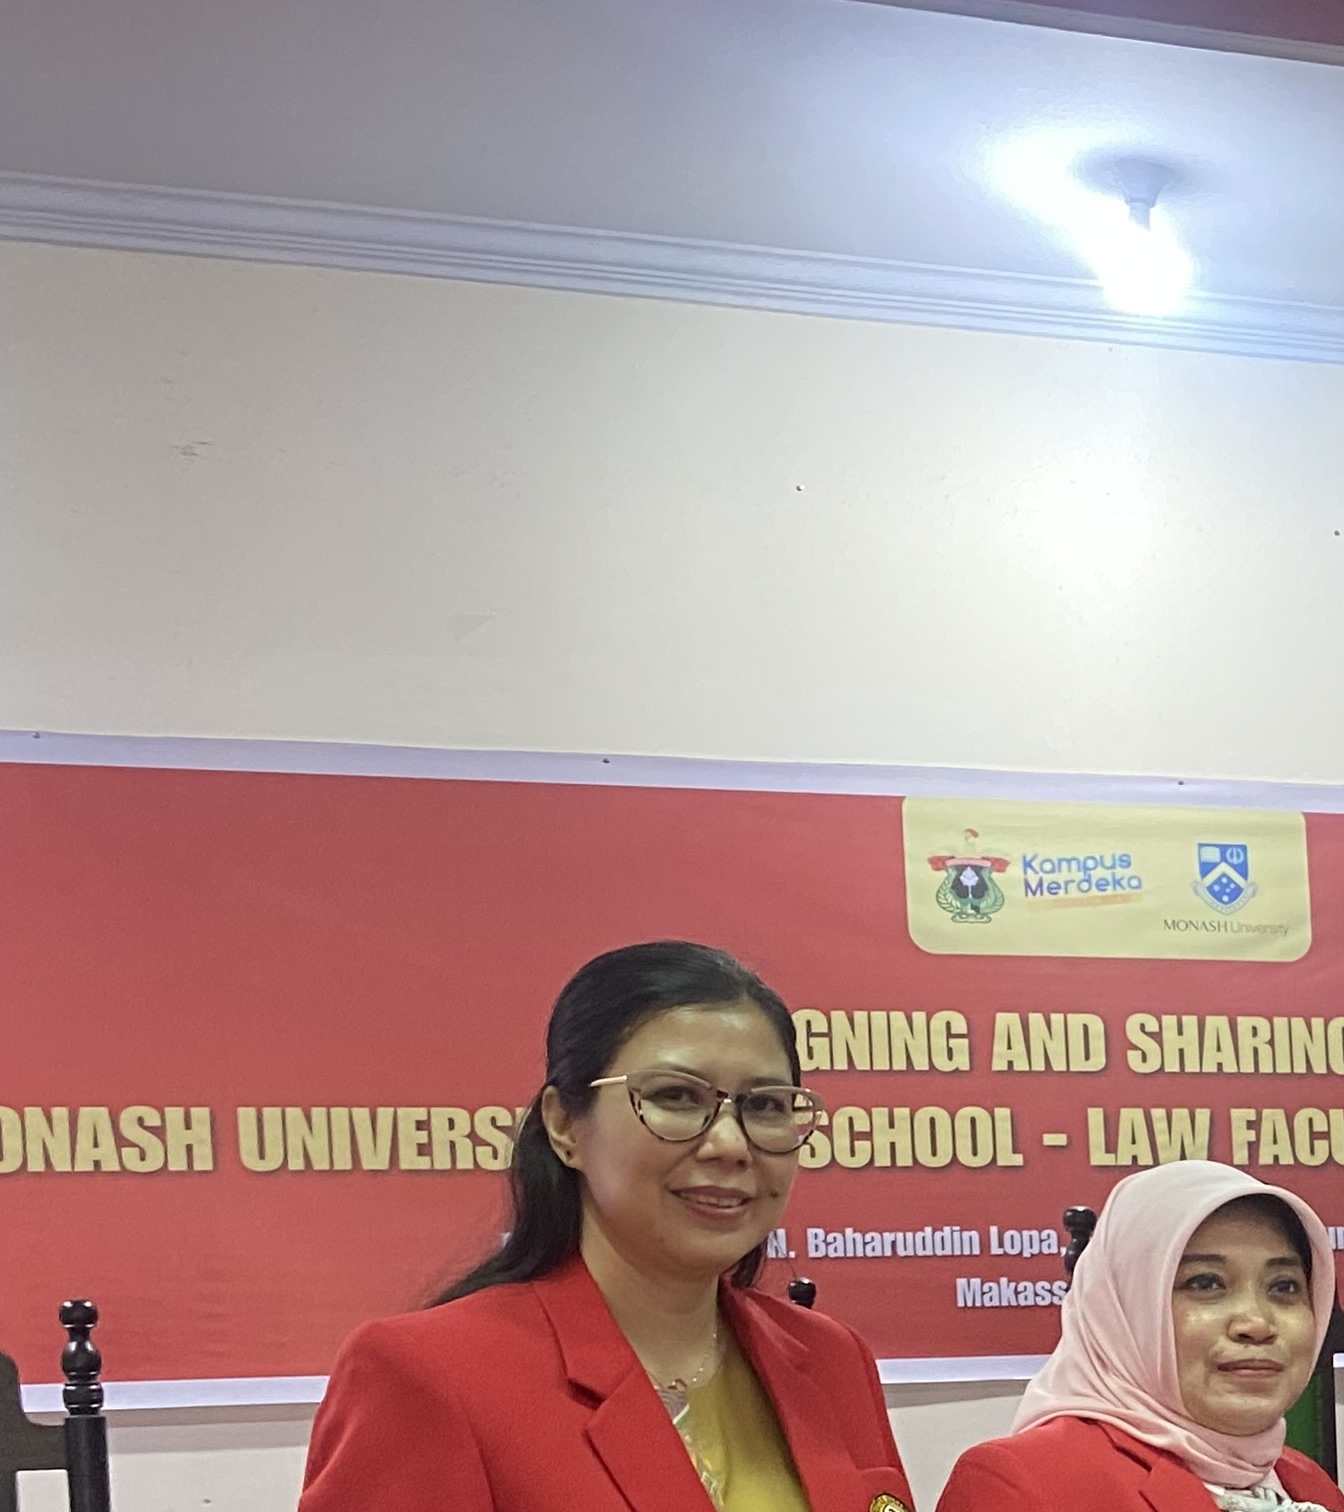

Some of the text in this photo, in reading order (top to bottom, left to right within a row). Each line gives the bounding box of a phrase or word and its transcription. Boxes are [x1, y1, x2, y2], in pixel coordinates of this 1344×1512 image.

[1021, 852, 1132, 877] Kampus
[1023, 872, 1143, 898] Merdeka
[1162, 919, 1290, 937] MONASH University
[990, 1011, 1107, 1073] AND
[237, 1106, 526, 1172] UNIVERS
[794, 1105, 1024, 1169] SCHOOL
[1042, 1132, 1069, 1148] -
[1087, 1107, 1211, 1167] LAW
[806, 1225, 981, 1259] Baharuddin
[989, 1225, 1068, 1259] Lopa,
